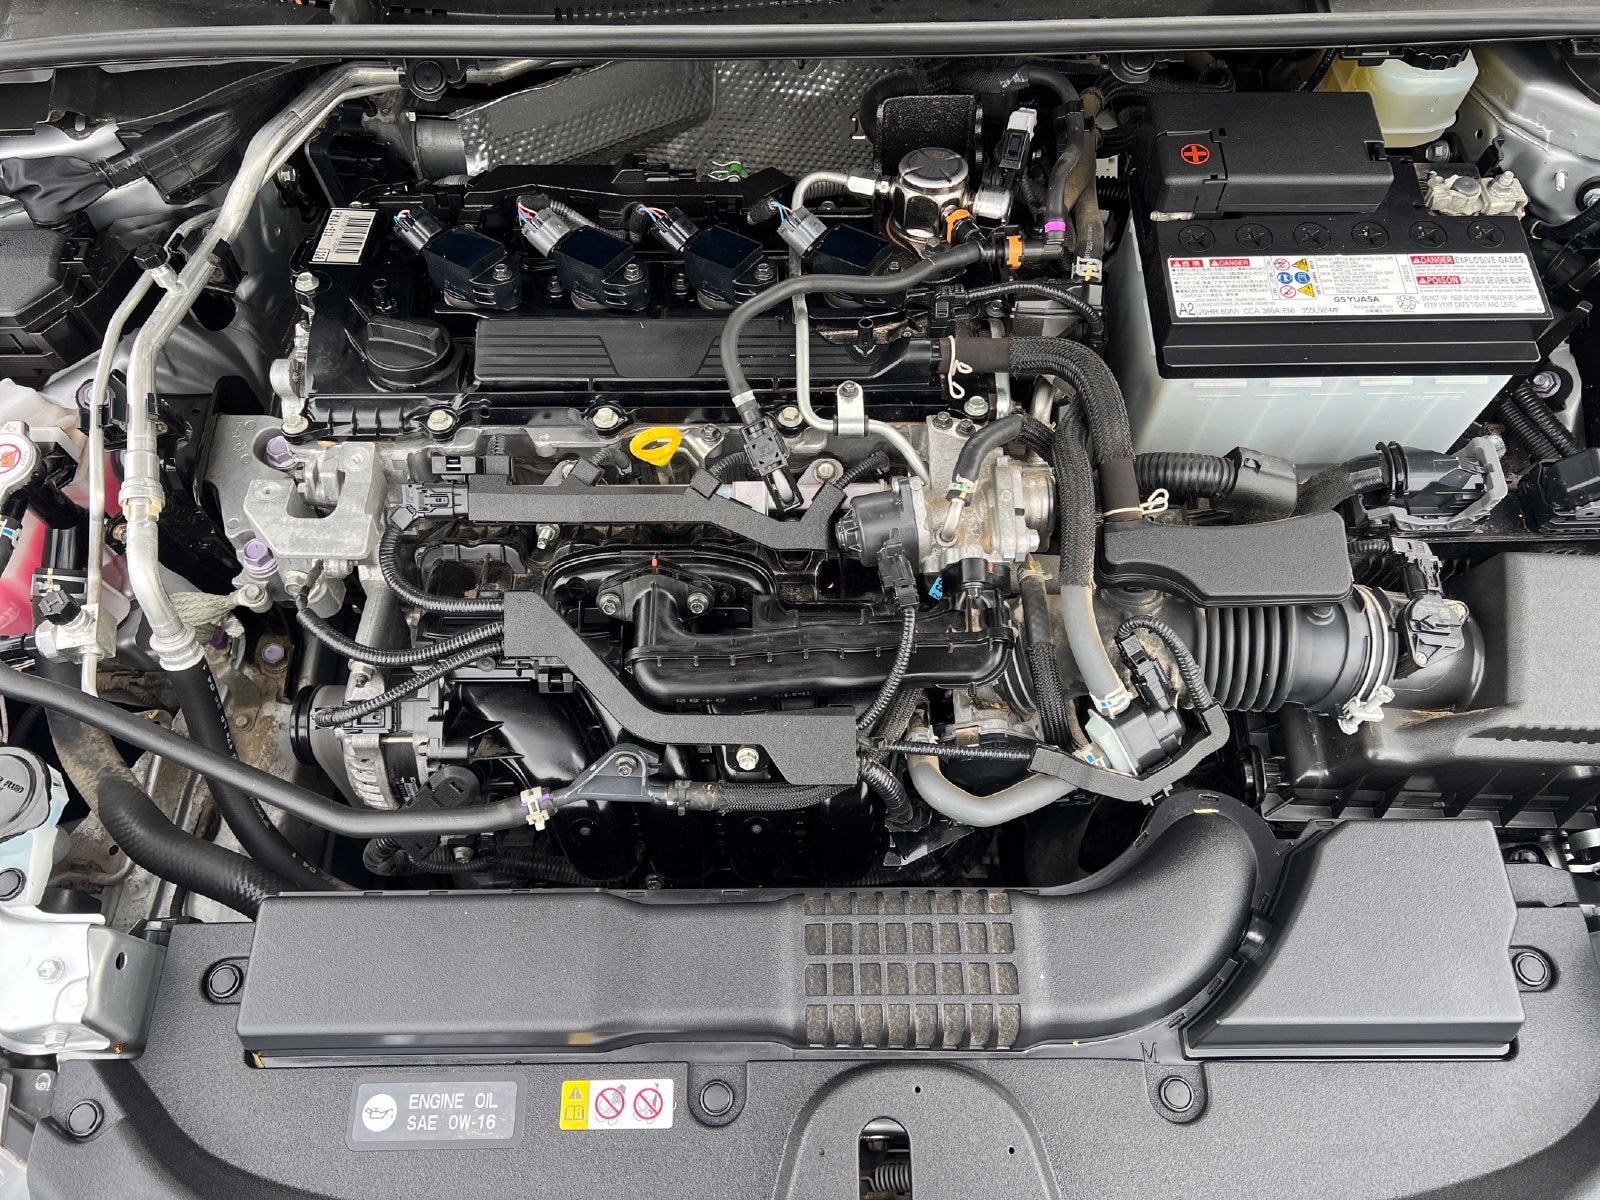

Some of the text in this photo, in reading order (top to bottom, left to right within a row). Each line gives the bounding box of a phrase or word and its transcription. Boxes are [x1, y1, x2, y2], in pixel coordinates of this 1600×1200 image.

[1455, 256, 1496, 264] EXPLOSIVE
[1427, 276, 1460, 285] POISON
[1462, 275, 1532, 284] CAUSES SEVERE BURNS
[1179, 302, 1196, 316] A2
[1140, 1041, 1160, 1064] M
[408, 1092, 499, 1110] ENGINE OIL
[406, 1114, 497, 1131] SAE 0W-16
